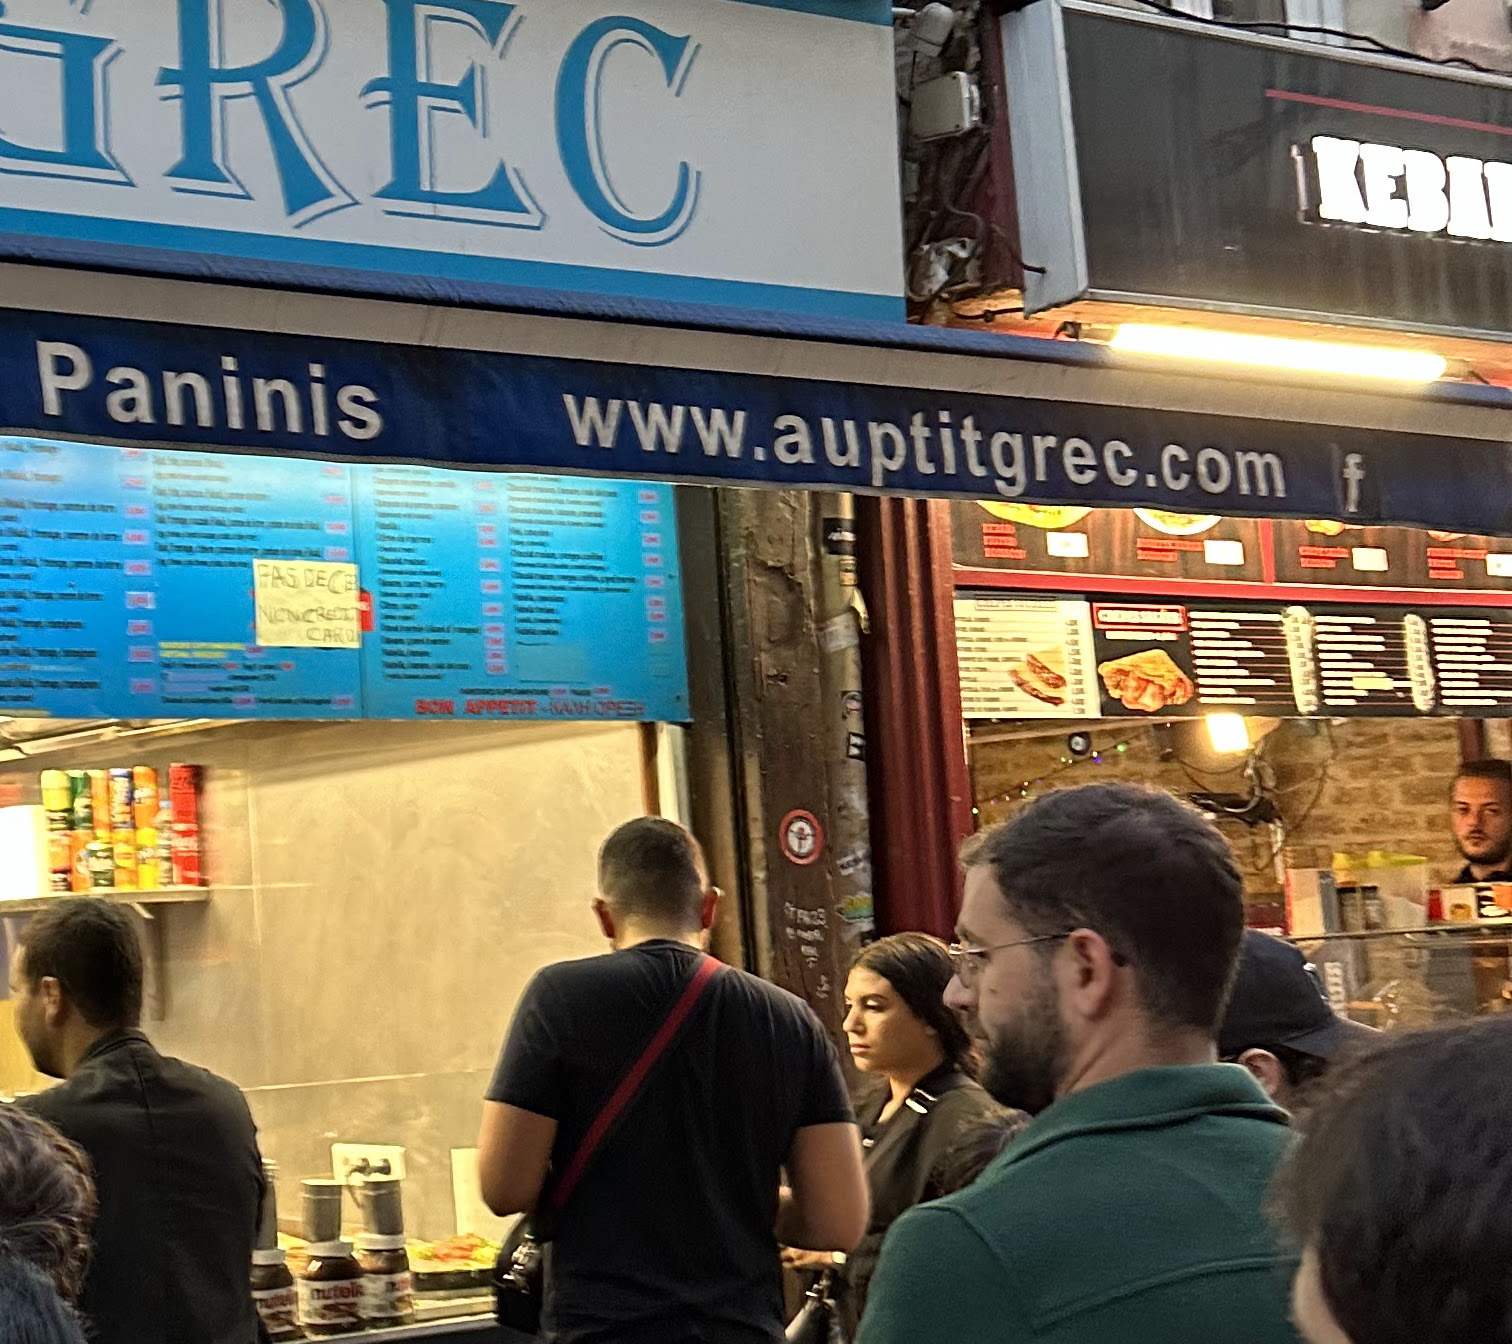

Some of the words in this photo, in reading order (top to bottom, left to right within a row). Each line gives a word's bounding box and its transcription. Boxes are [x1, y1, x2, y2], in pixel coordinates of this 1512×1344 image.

[35, 339, 385, 441] Paninis
[561, 392, 1286, 498] www.auptitgrec.com
[415, 698, 454, 715] BON
